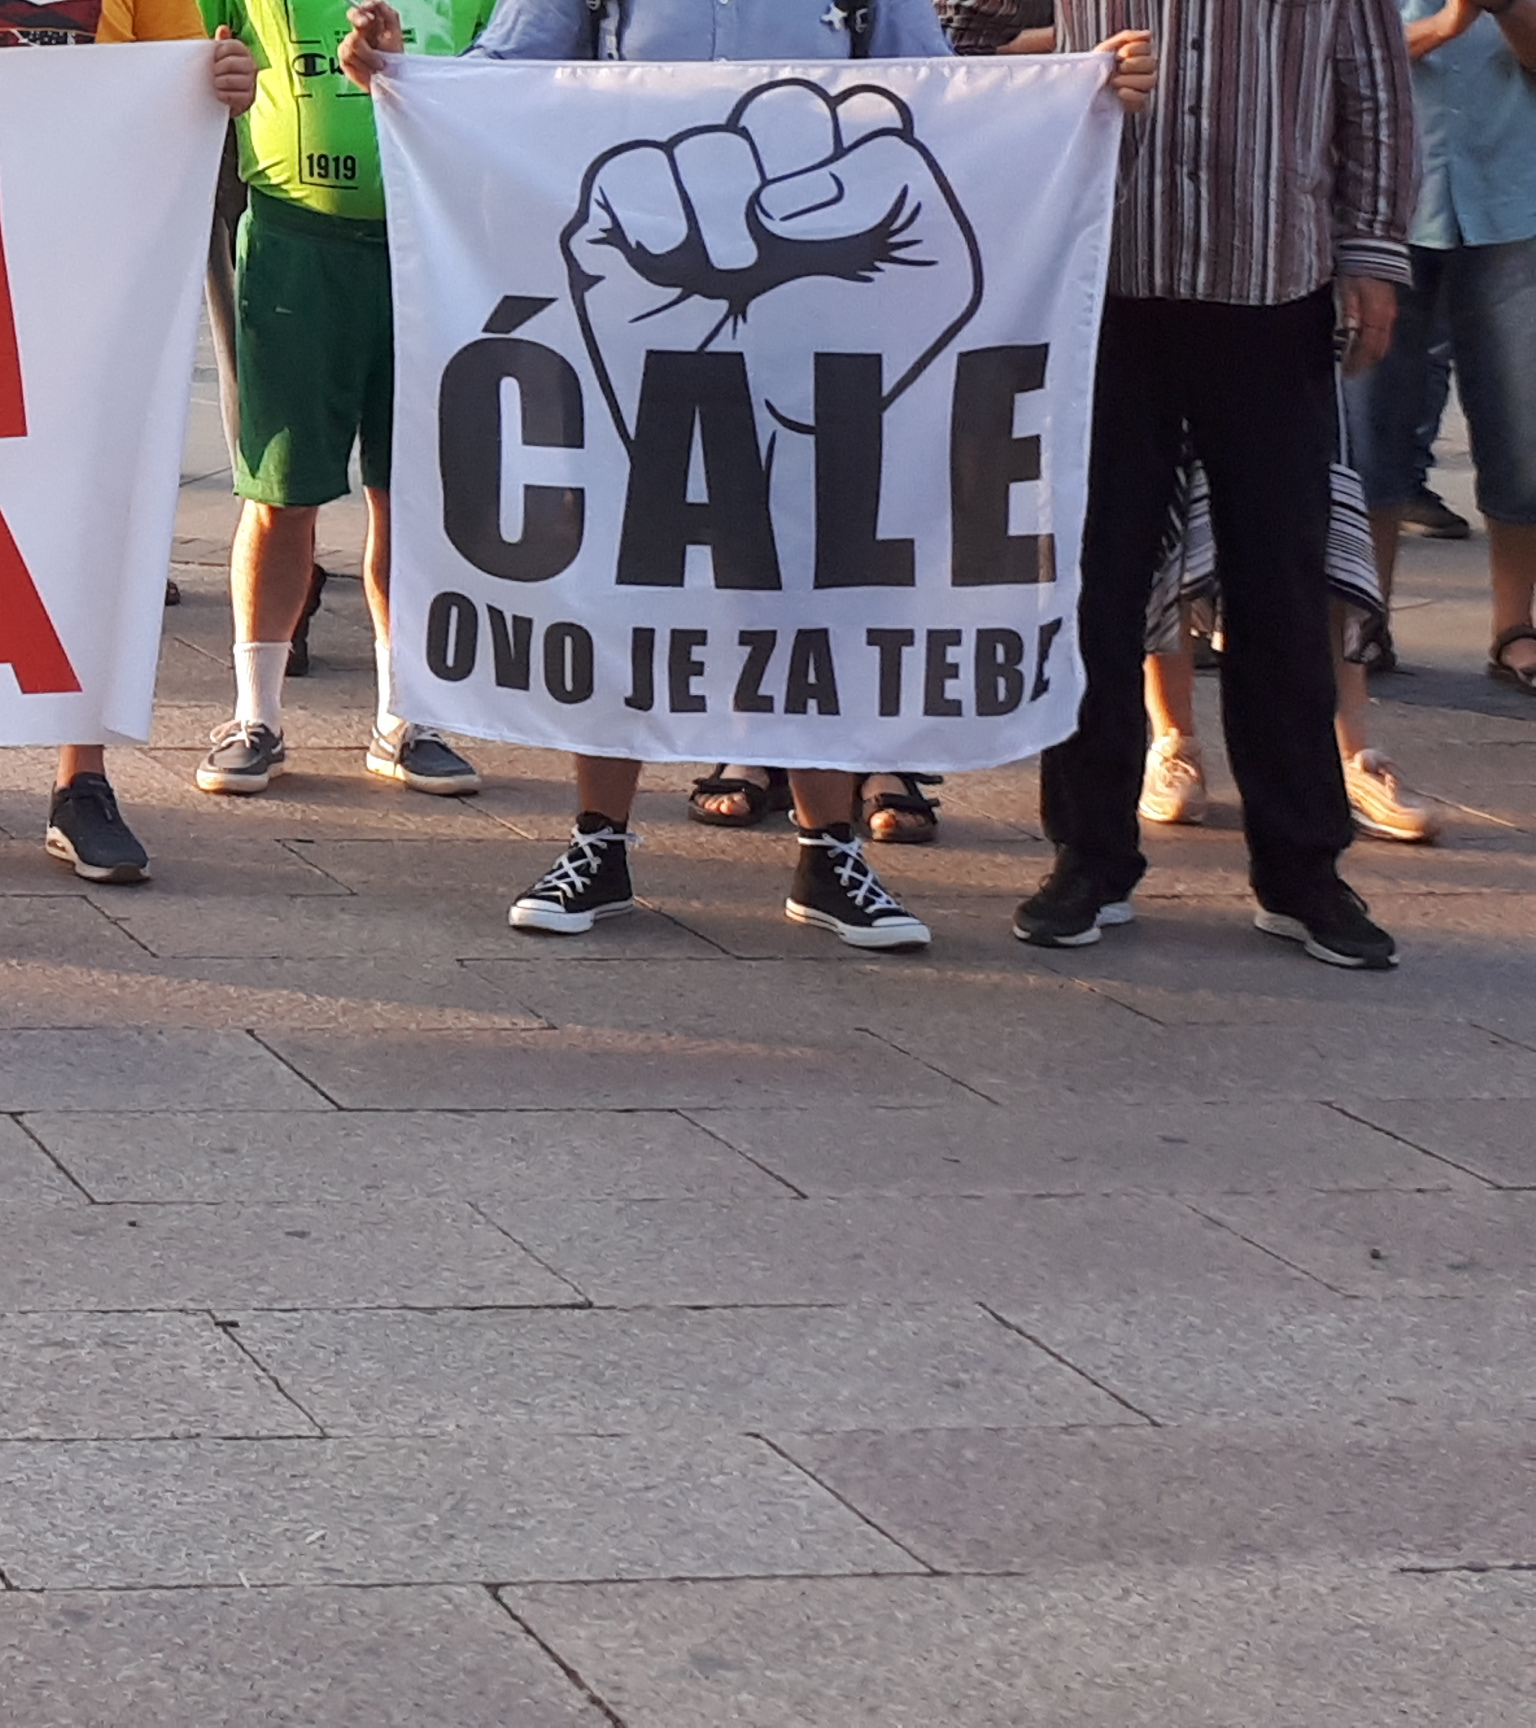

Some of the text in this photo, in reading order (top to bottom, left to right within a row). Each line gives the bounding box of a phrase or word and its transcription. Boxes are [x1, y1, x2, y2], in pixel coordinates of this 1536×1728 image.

[306, 153, 357, 180] 1919
[438, 295, 1058, 591] ĆALE
[427, 592, 594, 704] OVO
[625, 627, 708, 713] JE
[733, 628, 840, 716] ZA
